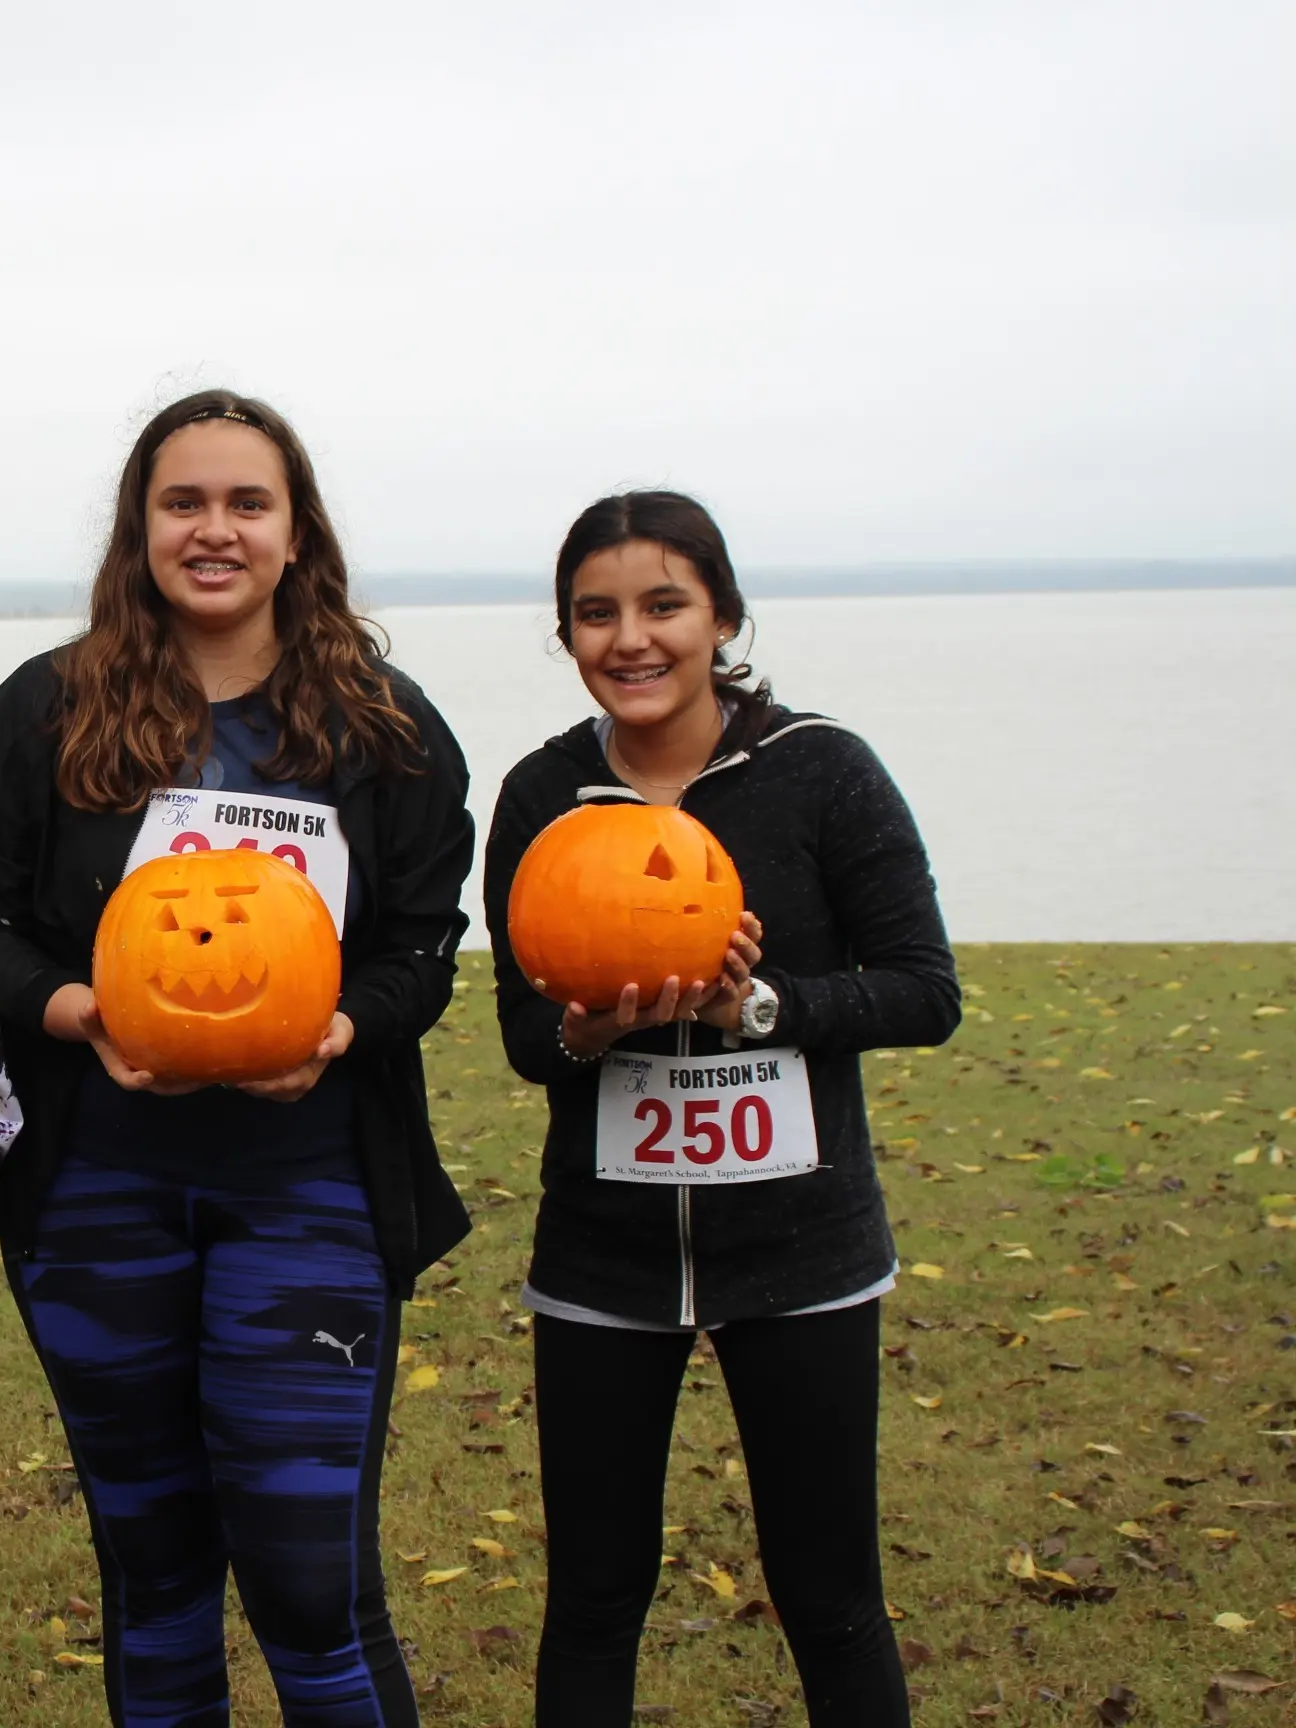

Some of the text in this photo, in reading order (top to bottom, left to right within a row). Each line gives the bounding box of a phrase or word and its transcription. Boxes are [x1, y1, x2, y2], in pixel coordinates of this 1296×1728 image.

[150, 793, 199, 804] FORTSON
[215, 803, 327, 838] FORTSON 5K
[669, 1060, 781, 1089] FORTSON 5K
[634, 1095, 773, 1165] 250
[615, 1161, 797, 1179] St. Margaret's School, Tappahannock, VA
